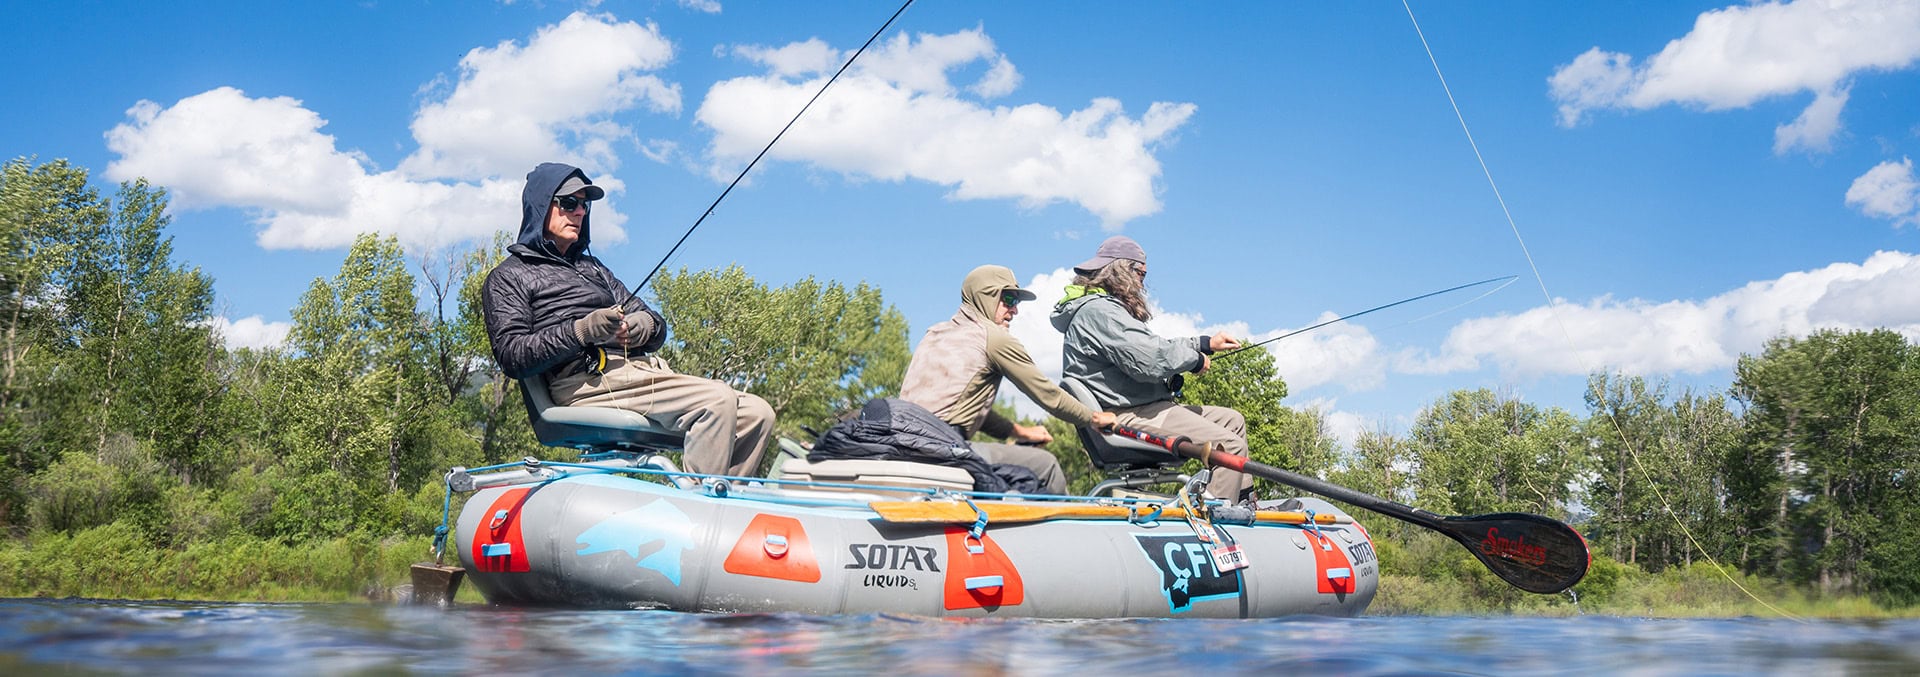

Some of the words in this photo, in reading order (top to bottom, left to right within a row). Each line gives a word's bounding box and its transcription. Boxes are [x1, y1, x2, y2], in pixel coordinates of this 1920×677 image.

[844, 543, 940, 572] SOTAR
[1219, 551, 1243, 565] 10797
[863, 574, 909, 588] LIQUID
